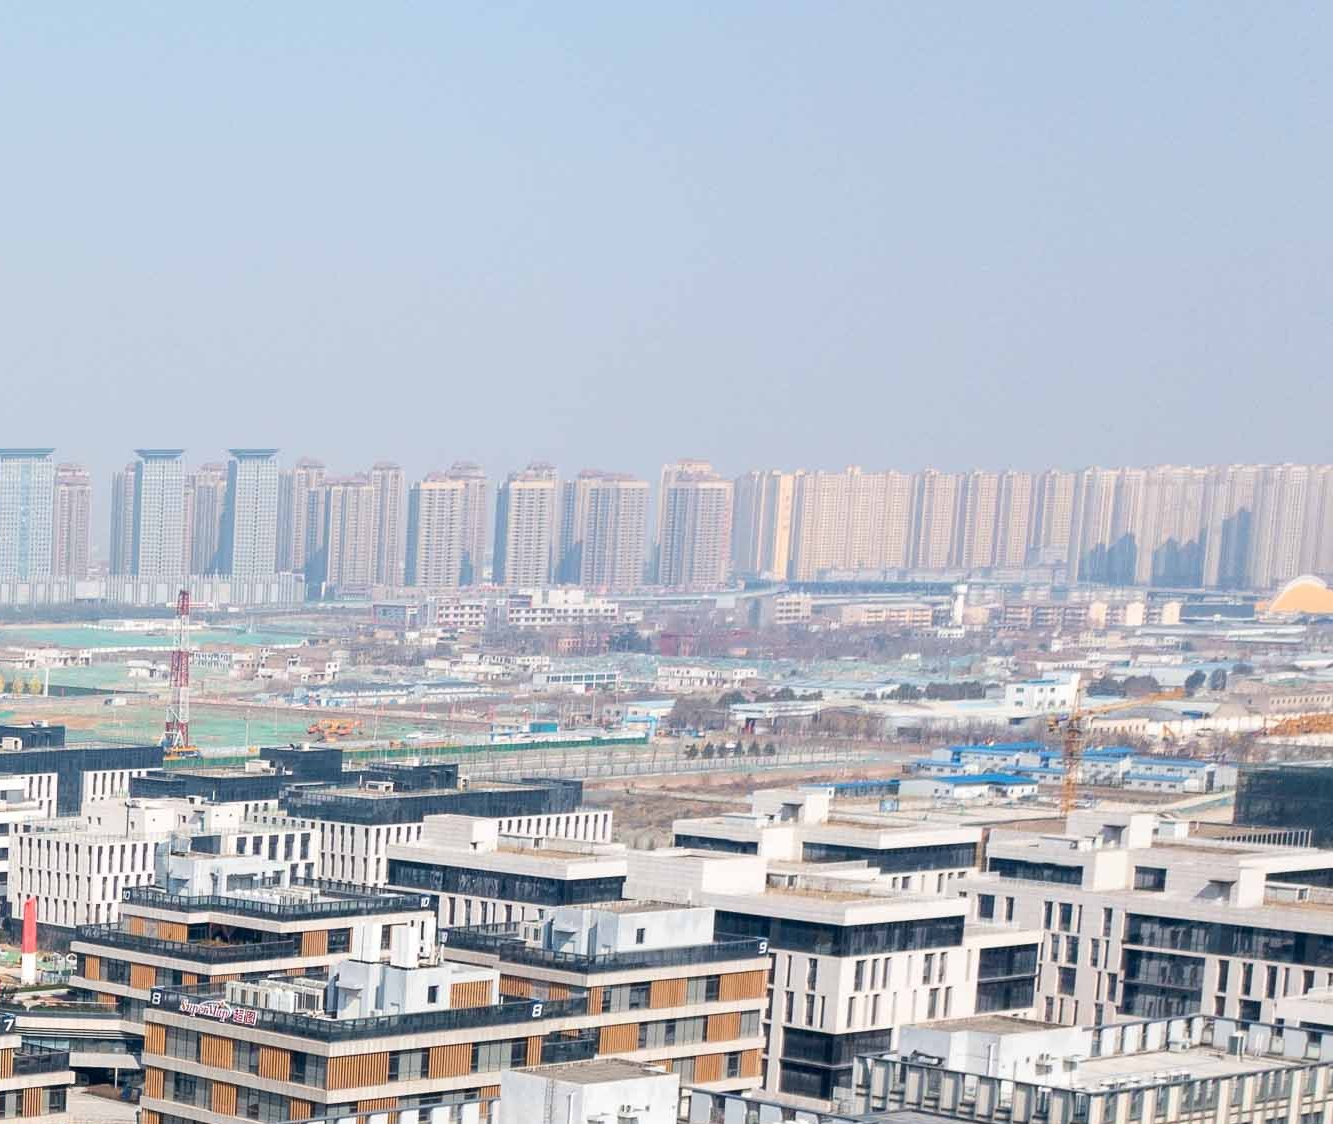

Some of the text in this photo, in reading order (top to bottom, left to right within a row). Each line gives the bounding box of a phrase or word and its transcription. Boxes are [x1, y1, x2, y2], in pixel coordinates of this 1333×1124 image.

[758, 941, 768, 954] 9
[151, 992, 162, 1005] 8
[180, 998, 230, 1022] SuperMap
[532, 1003, 543, 1017] 8
[4, 1018, 14, 1032] 7
